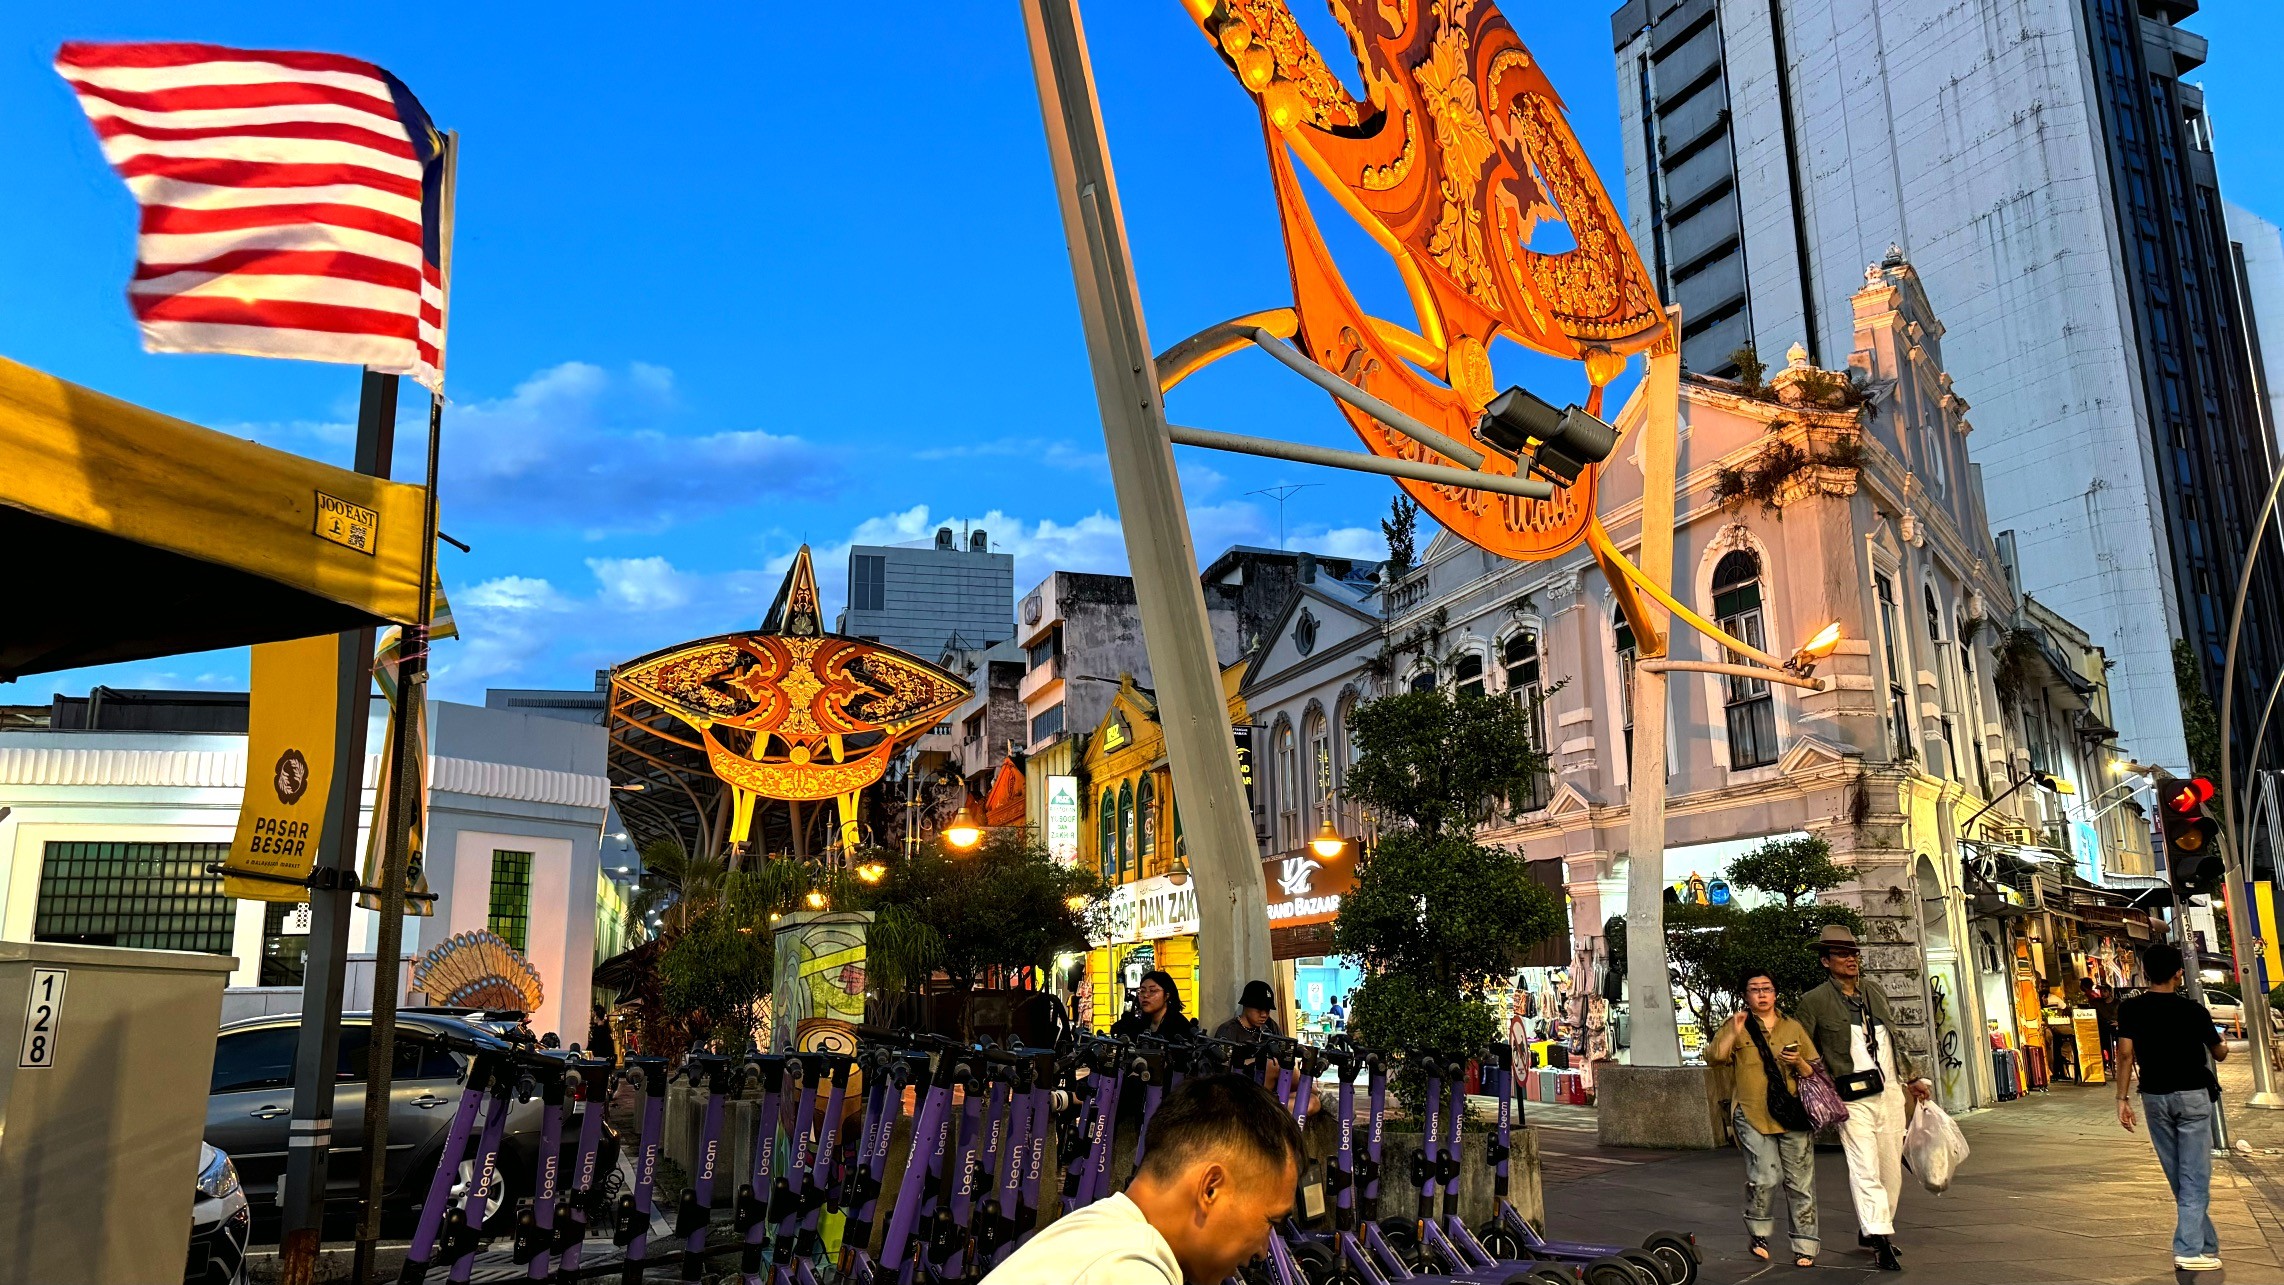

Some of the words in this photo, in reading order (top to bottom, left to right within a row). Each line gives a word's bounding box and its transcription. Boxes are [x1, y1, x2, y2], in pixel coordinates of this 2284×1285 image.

[255, 817, 309, 839] PASAR
[250, 836, 305, 856] BESAR
[1140, 895, 1164, 929] DAN
[1267, 902, 1294, 919] RAND
[1295, 895, 1340, 916] BAZAAR
[2184, 916, 2192, 941] 128
[30, 975, 54, 1063] 128
[1092, 1114, 1106, 1145] beam
[1372, 1111, 1383, 1143] beam
[1428, 1111, 1439, 1142] beam
[1453, 1113, 1463, 1143] beam
[1499, 1101, 1508, 1129] beam
[792, 1131, 808, 1168] beam
[819, 1129, 836, 1165] beam
[863, 1123, 878, 1157] beam
[875, 1121, 893, 1156] beam
[935, 1121, 949, 1156] beam
[988, 1119, 1000, 1153] beam
[1340, 1119, 1350, 1150] beam
[640, 1144, 656, 1185] beam
[700, 1140, 717, 1180] beam
[757, 1137, 773, 1176] beam
[958, 1150, 976, 1195] beam
[1006, 1145, 1022, 1189] beam
[1027, 1138, 1043, 1180] beam
[474, 1152, 496, 1197] beam
[539, 1155, 556, 1199] beam
